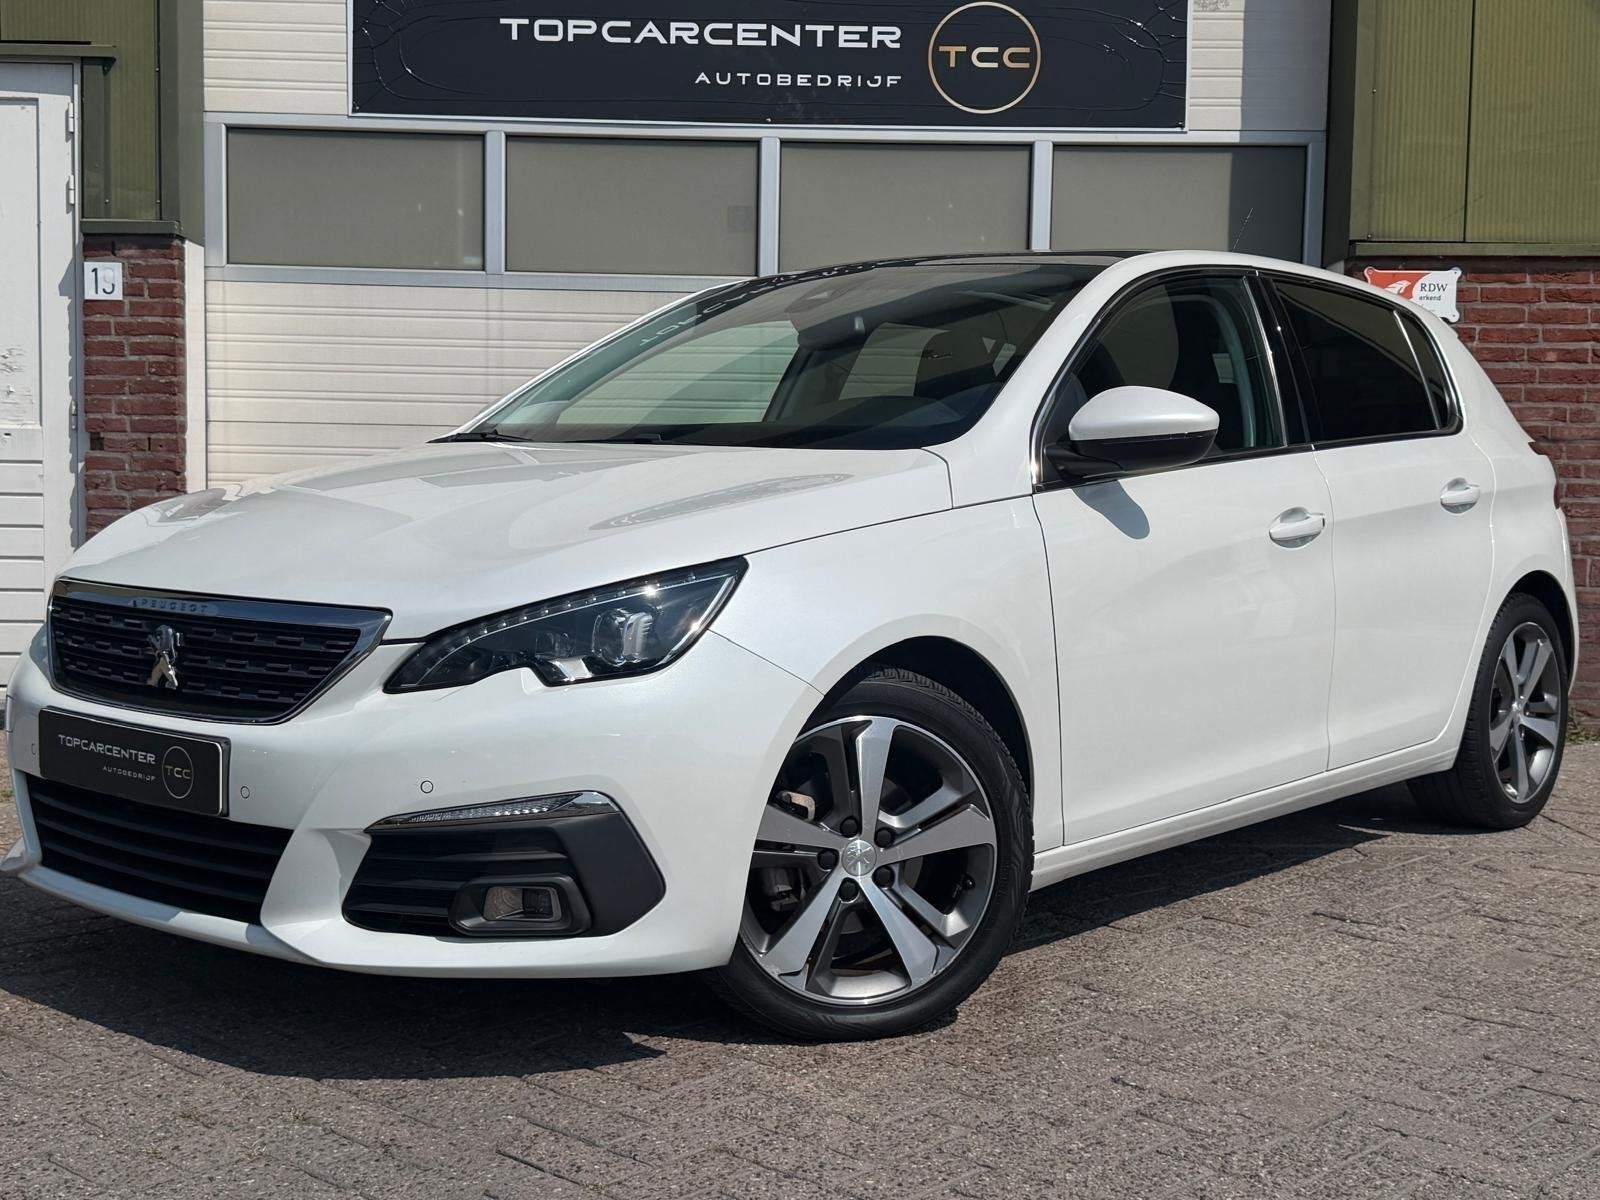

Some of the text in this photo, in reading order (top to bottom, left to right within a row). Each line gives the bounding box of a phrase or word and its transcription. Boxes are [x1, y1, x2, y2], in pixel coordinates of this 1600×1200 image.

[499, 17, 903, 50] TOPCARCENTER
[938, 44, 1031, 69] TCC
[694, 71, 902, 88] AUTOBEDRIJF
[1420, 282, 1448, 292] RDW
[142, 598, 208, 613] PEUGEOT
[58, 734, 156, 765] TOPCARCENTER
[102, 765, 156, 781] AUTOBEDRIJF
[164, 765, 191, 780] TCC
